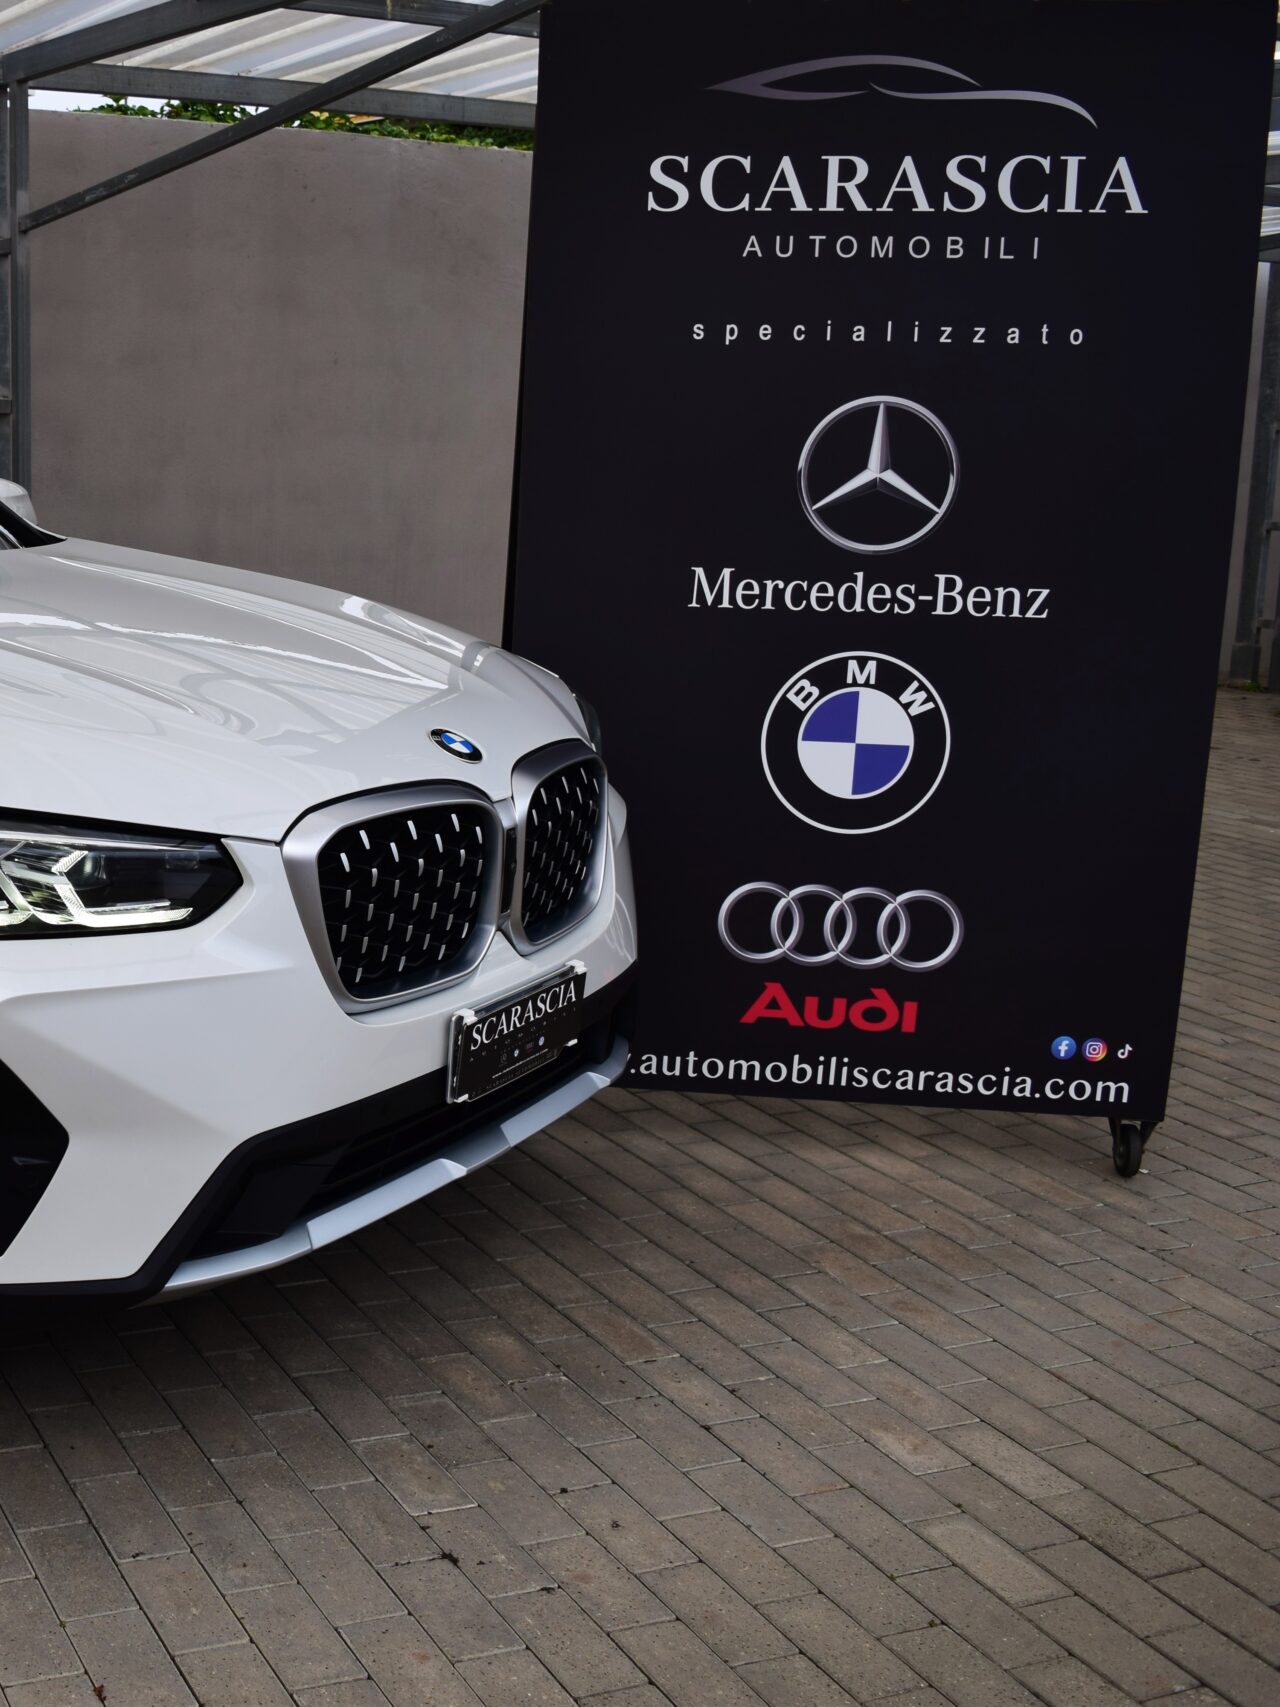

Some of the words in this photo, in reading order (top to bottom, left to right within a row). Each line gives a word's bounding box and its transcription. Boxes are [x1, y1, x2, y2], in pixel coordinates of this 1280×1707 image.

[647, 154, 1149, 214] SCARASCIA
[742, 235, 1040, 260] AUTOMOBILI
[692, 319, 1084, 347] specializzato
[687, 566, 1051, 619] Mercedes-Benz
[786, 659, 935, 718] BMW
[470, 980, 577, 1051] SCARASCIA
[740, 982, 918, 1033] Audi
[627, 1050, 1132, 1103] .automobiliscarascia.com
